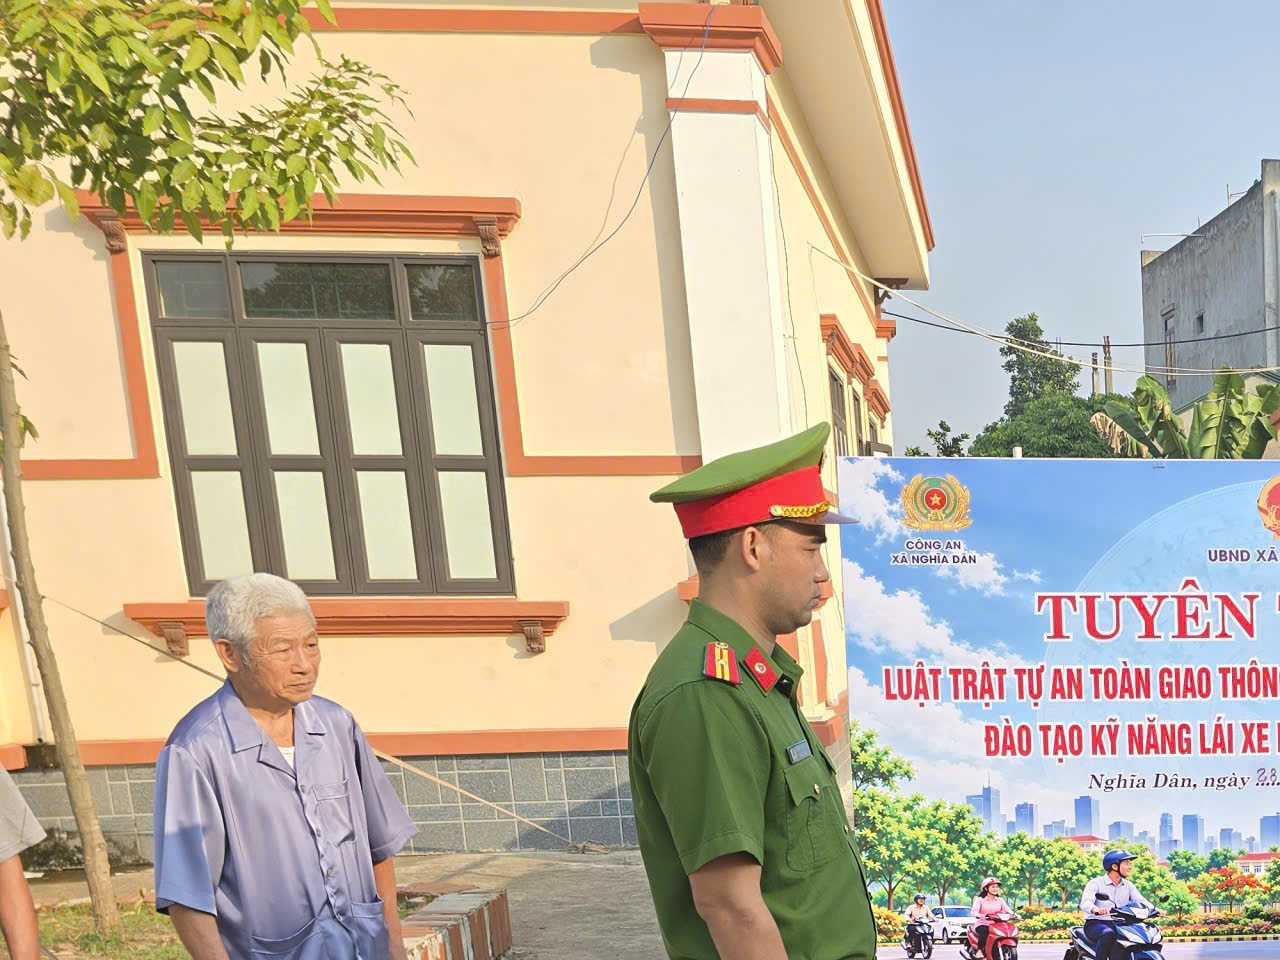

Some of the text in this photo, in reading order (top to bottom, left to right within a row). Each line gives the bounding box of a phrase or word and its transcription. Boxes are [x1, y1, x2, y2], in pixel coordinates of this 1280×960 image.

[906, 538, 961, 550] CÔNG AN
[1208, 549, 1251, 562] UBND
[1256, 546, 1278, 562] XÃ
[891, 552, 976, 564] XÃ NGHĨA DÂN
[1036, 579, 1257, 640] TUYÊN
[884, 661, 942, 707] LUẬT
[949, 661, 1007, 707] TRẬT
[1014, 665, 1045, 707] TỰ
[1051, 668, 1083, 699] AN
[1090, 660, 1150, 699] TOÀN
[1158, 667, 1212, 698] GIAO
[985, 718, 1032, 757] ĐÀO
[1039, 725, 1083, 763] TẠO
[1091, 718, 1120, 756] KỸ
[1128, 717, 1192, 756] NĂNG
[1200, 716, 1233, 754] LÁI
[1241, 722, 1269, 754] XE
[1088, 774, 1146, 792] Nghĩa
[1152, 773, 1198, 790] Dân,
[1204, 772, 1250, 790] ngày
